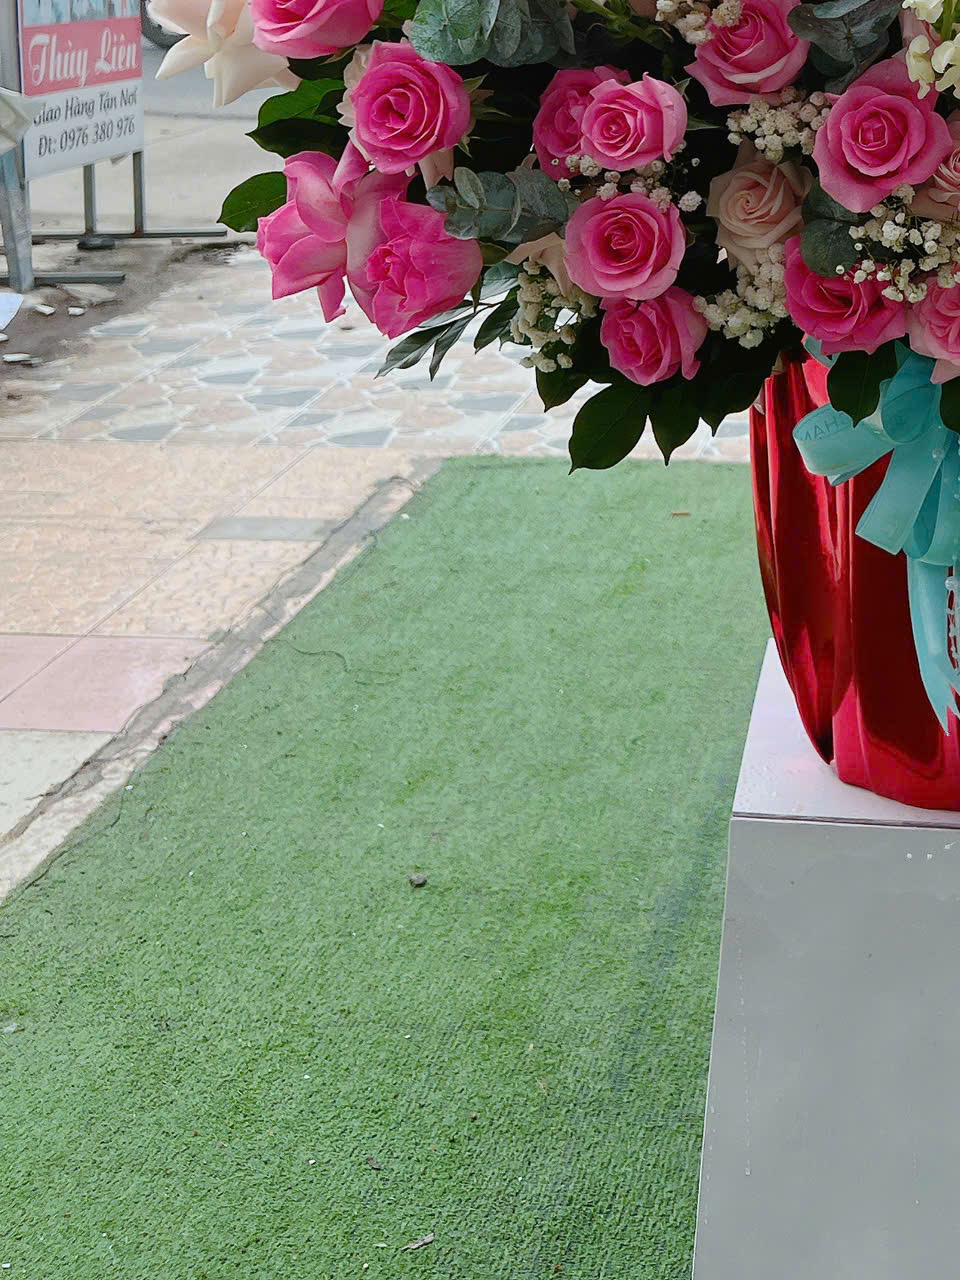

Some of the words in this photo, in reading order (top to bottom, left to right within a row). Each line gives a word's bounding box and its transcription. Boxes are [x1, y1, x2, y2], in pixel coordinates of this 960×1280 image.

[64, 95, 95, 120] Hàng
[120, 86, 138, 109] Nơi
[59, 124, 89, 153] 0976
[92, 118, 114, 145] 380
[115, 113, 136, 138] 976
